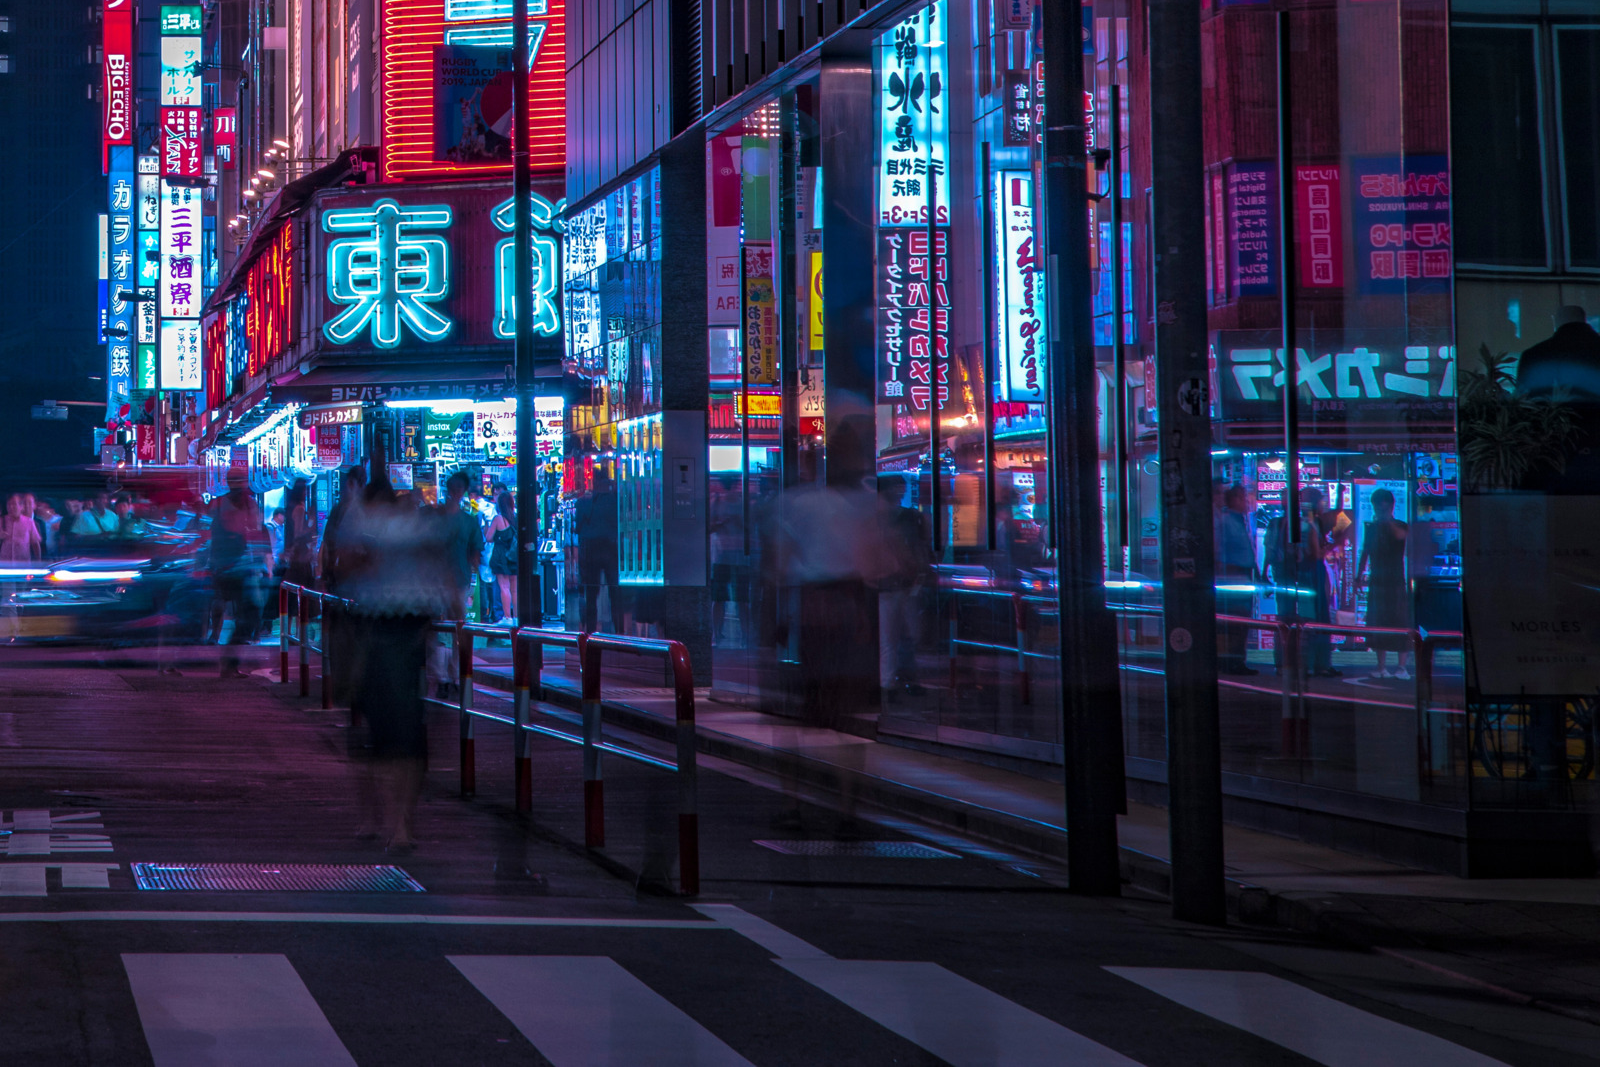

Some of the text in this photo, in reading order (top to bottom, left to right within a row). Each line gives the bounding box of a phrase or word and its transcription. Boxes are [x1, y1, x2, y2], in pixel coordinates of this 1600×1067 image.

[442, 58, 477, 67] RUGBY
[442, 68, 480, 77] WORLD
[167, 68, 180, 95] ホール
[108, 54, 125, 140] BIG ECHO
[188, 140, 199, 174] シーアン
[144, 195, 158, 223] ねぎし
[331, 385, 430, 401] ヨドバシカメラ
[304, 408, 359, 425] ヨドバシカメラ
[428, 422, 450, 431] instax
[324, 437, 339, 445] 9:30
[1511, 621, 1582, 633] MORLES
